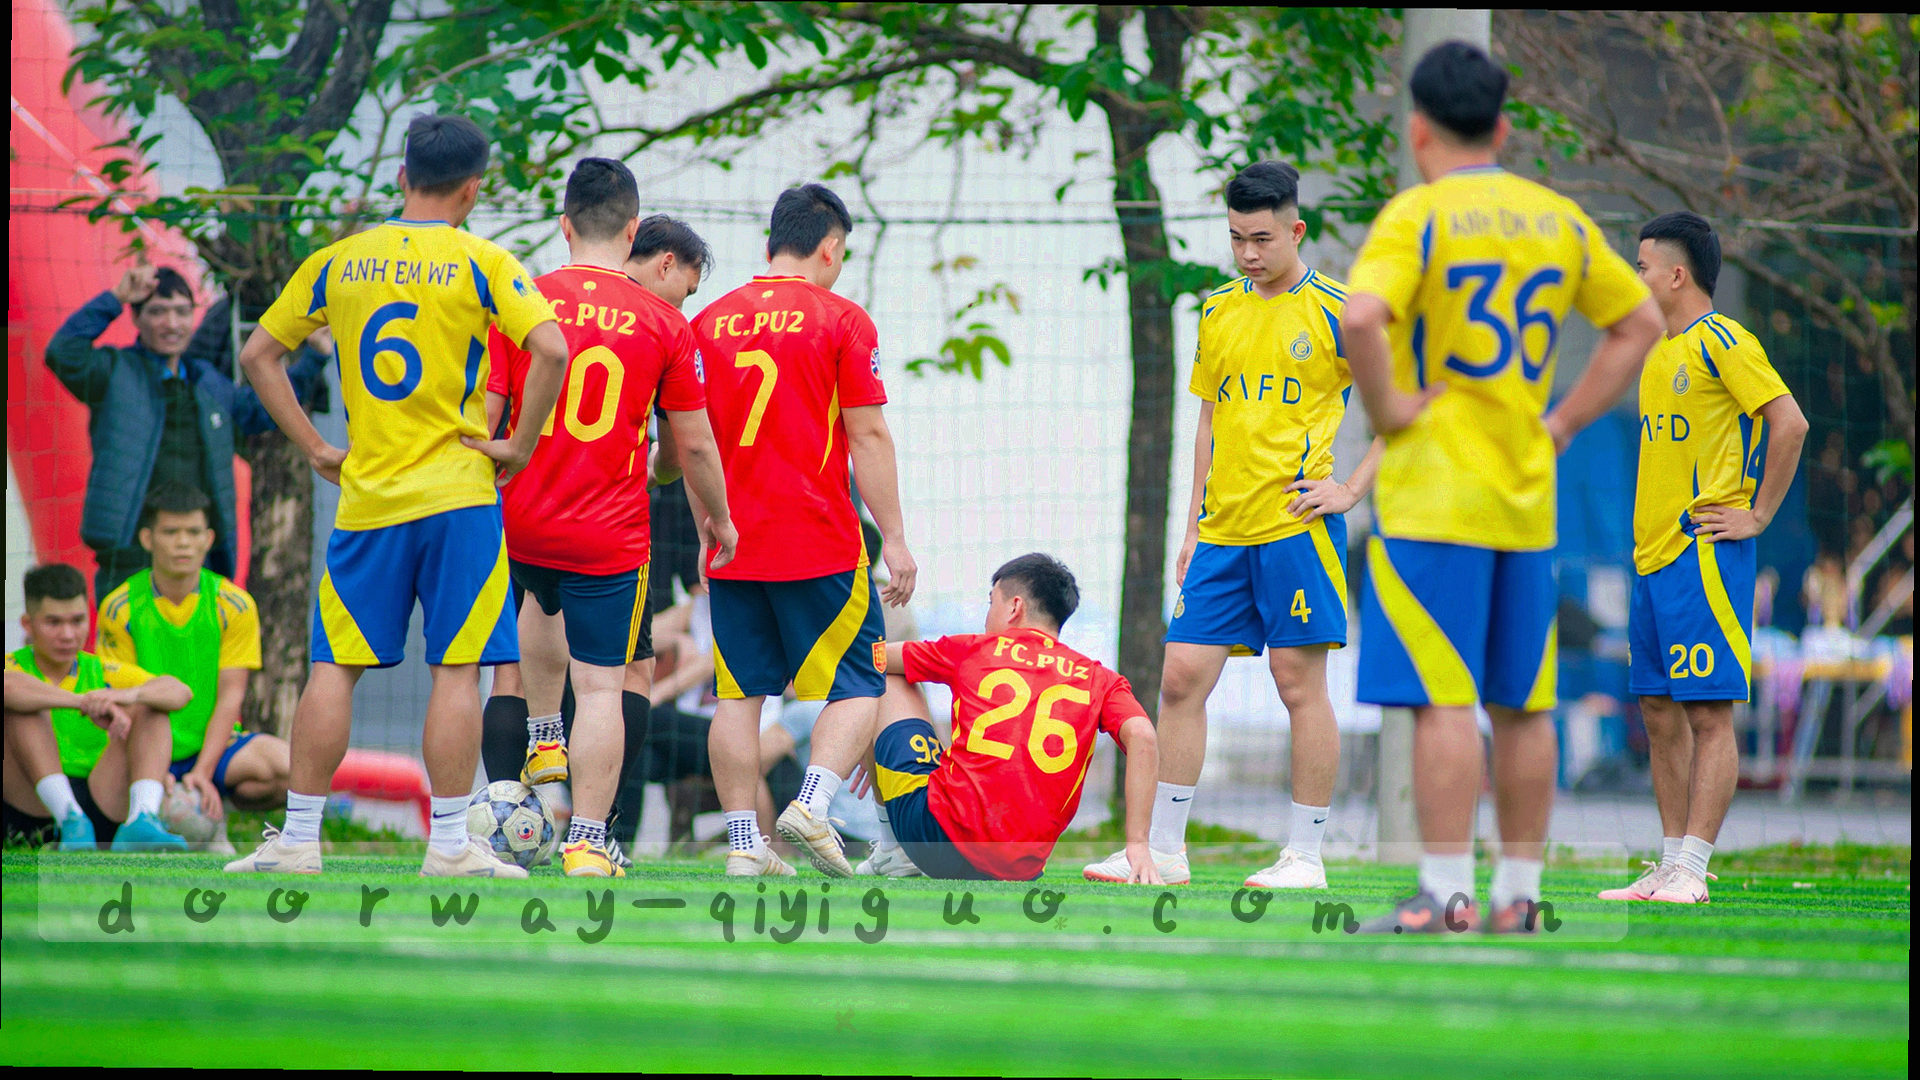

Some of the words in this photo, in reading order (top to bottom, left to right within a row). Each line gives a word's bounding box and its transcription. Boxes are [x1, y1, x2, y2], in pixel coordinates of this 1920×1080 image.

[340, 258, 389, 283] ANH
[395, 260, 421, 285] EM
[428, 261, 458, 286] WF
[547, 299, 637, 335] C.PU2
[713, 310, 805, 339] FC.PU2
[1445, 263, 1562, 381] 36
[359, 301, 423, 402] 6
[734, 349, 779, 447] 7
[1290, 588, 1312, 624] 4
[1669, 642, 1715, 679] 20
[966, 668, 1091, 774] 26
